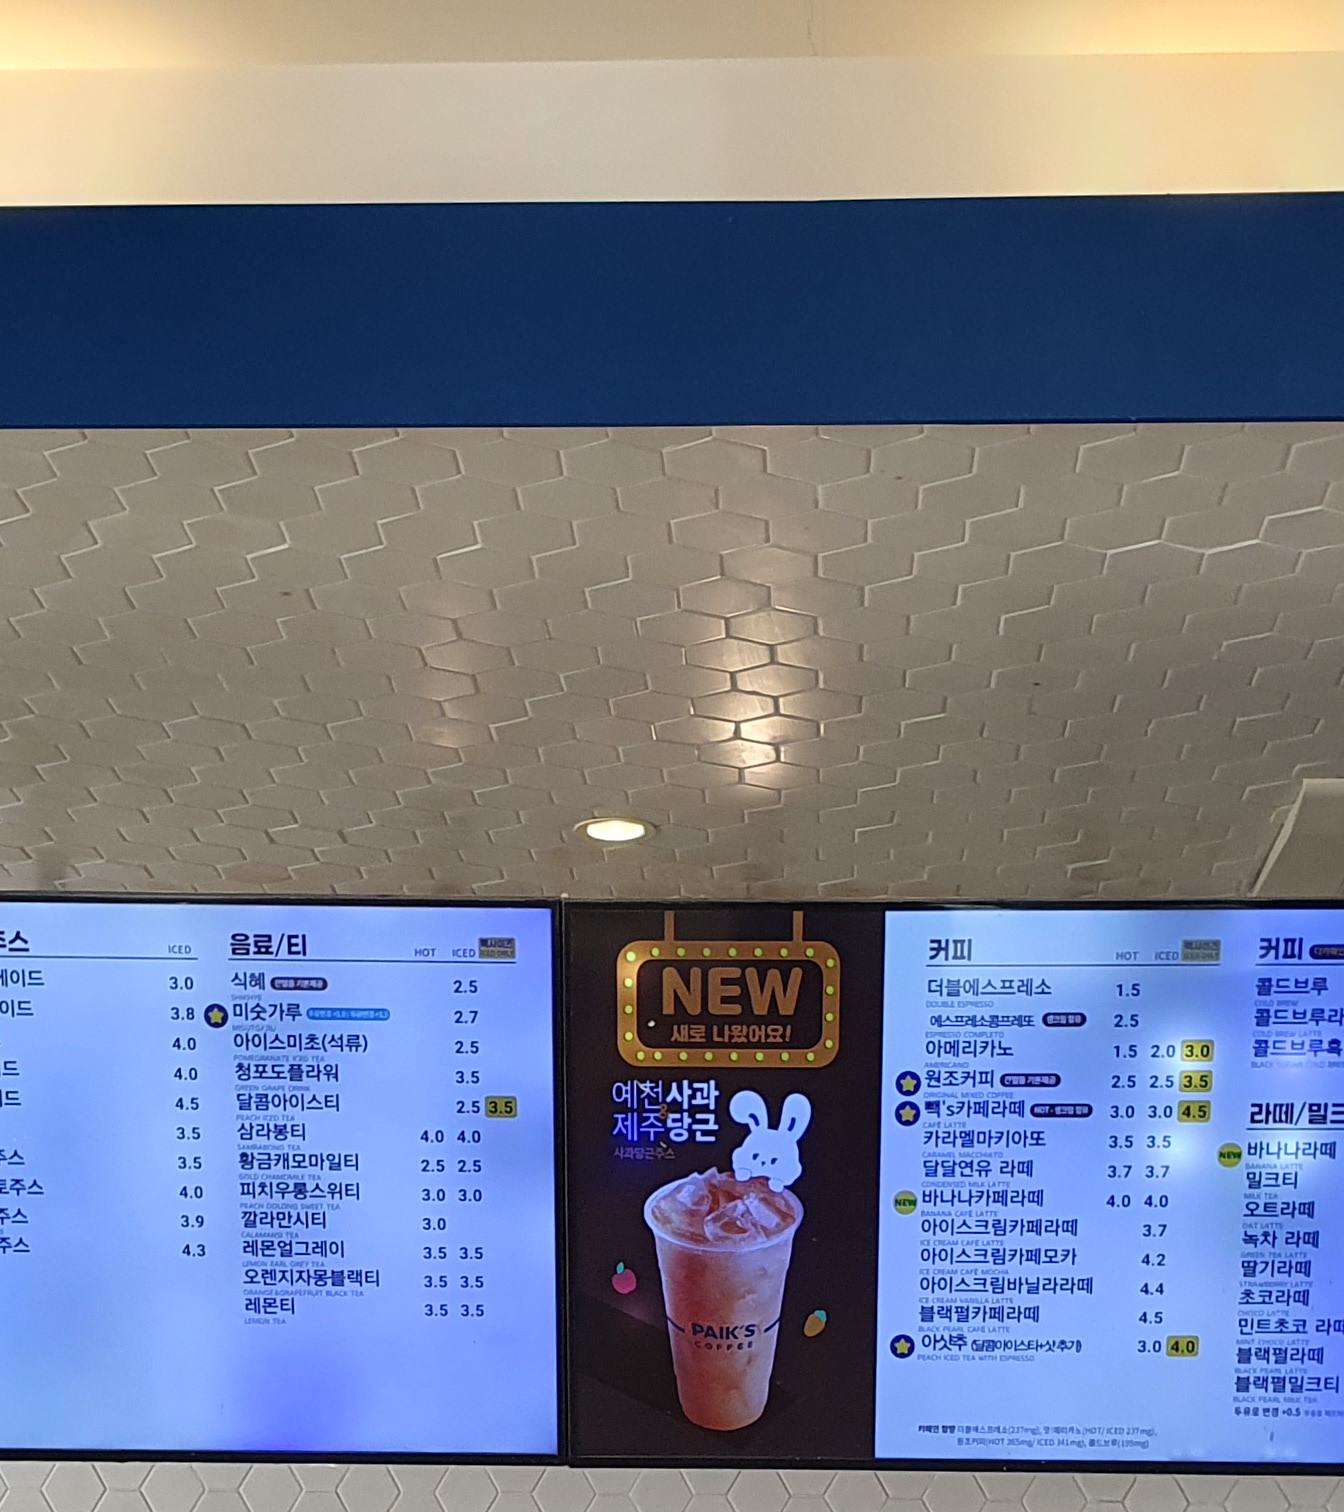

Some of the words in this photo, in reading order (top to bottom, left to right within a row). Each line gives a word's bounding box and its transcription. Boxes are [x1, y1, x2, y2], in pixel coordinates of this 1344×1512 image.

[229, 933, 308, 957] 음료/티
[415, 948, 436, 957] HOT
[452, 948, 475, 958] ICED
[929, 939, 973, 962] 커피
[1259, 938, 1304, 960] 커피
[231, 972, 266, 991] 식혜
[927, 978, 1052, 997] 더블에스프레소
[1256, 977, 1328, 996] 콜드브루
[662, 967, 803, 1015] NEW
[232, 1003, 302, 1022] 미숫가루
[671, 1025, 706, 1042] 새로
[713, 1025, 791, 1042] 나왔어요!
[233, 1034, 368, 1053] 아이스미초(석류)
[925, 1040, 1014, 1057] 아메리카노
[1113, 1045, 1138, 1058] 1.5
[1150, 1045, 1175, 1058] 2.0
[1184, 1045, 1210, 1058] 3.0
[235, 1064, 339, 1082] 청포도플라워
[925, 1070, 994, 1088] 원조커피
[236, 1094, 340, 1111] 달콤아이스티
[612, 1080, 719, 1109] 예천사과
[237, 1123, 306, 1141] 삼라봉티
[613, 1112, 719, 1142] 제주당근
[923, 1130, 1046, 1148] 카라멜마키아또
[1247, 1141, 1337, 1159] 바나나라떼
[239, 1153, 359, 1172] 황금캐모마일티
[923, 1160, 992, 1178] 달달연유
[1000, 1160, 1033, 1178] 라떼
[1246, 1172, 1298, 1190] 밀크티
[240, 1183, 360, 1200] 피치우롱스위티
[922, 1189, 1044, 1208] 바나나카페라떼
[1243, 1201, 1315, 1219] 오트라떼
[241, 1211, 327, 1229] 깔라만시티
[921, 1219, 1078, 1237] 아이스크림카페라떼
[1241, 1231, 1278, 1248] 녹차
[1285, 1231, 1319, 1248] 라떼
[242, 1240, 345, 1259] 레몬얼그레이
[920, 1248, 1077, 1266] 아이스크림카페모카
[243, 1269, 380, 1287] 오렌지자몽블랙티
[1241, 1260, 1311, 1278] 딸기라떼
[920, 1277, 1093, 1295] 아이스크림바닐라라떼
[244, 1297, 295, 1315] 레몬티
[1239, 1289, 1310, 1306] 초코라떼
[919, 1306, 1040, 1323] 블랙펄카페라떼
[691, 1322, 756, 1340] PAIK'S
[1238, 1318, 1308, 1335] 민트초코
[695, 1341, 753, 1351] COFFEE
[922, 1334, 967, 1352] 아샷추
[1236, 1347, 1324, 1365] 블랙펄라떼
[1235, 1376, 1340, 1393] 블랙펄밀크티
